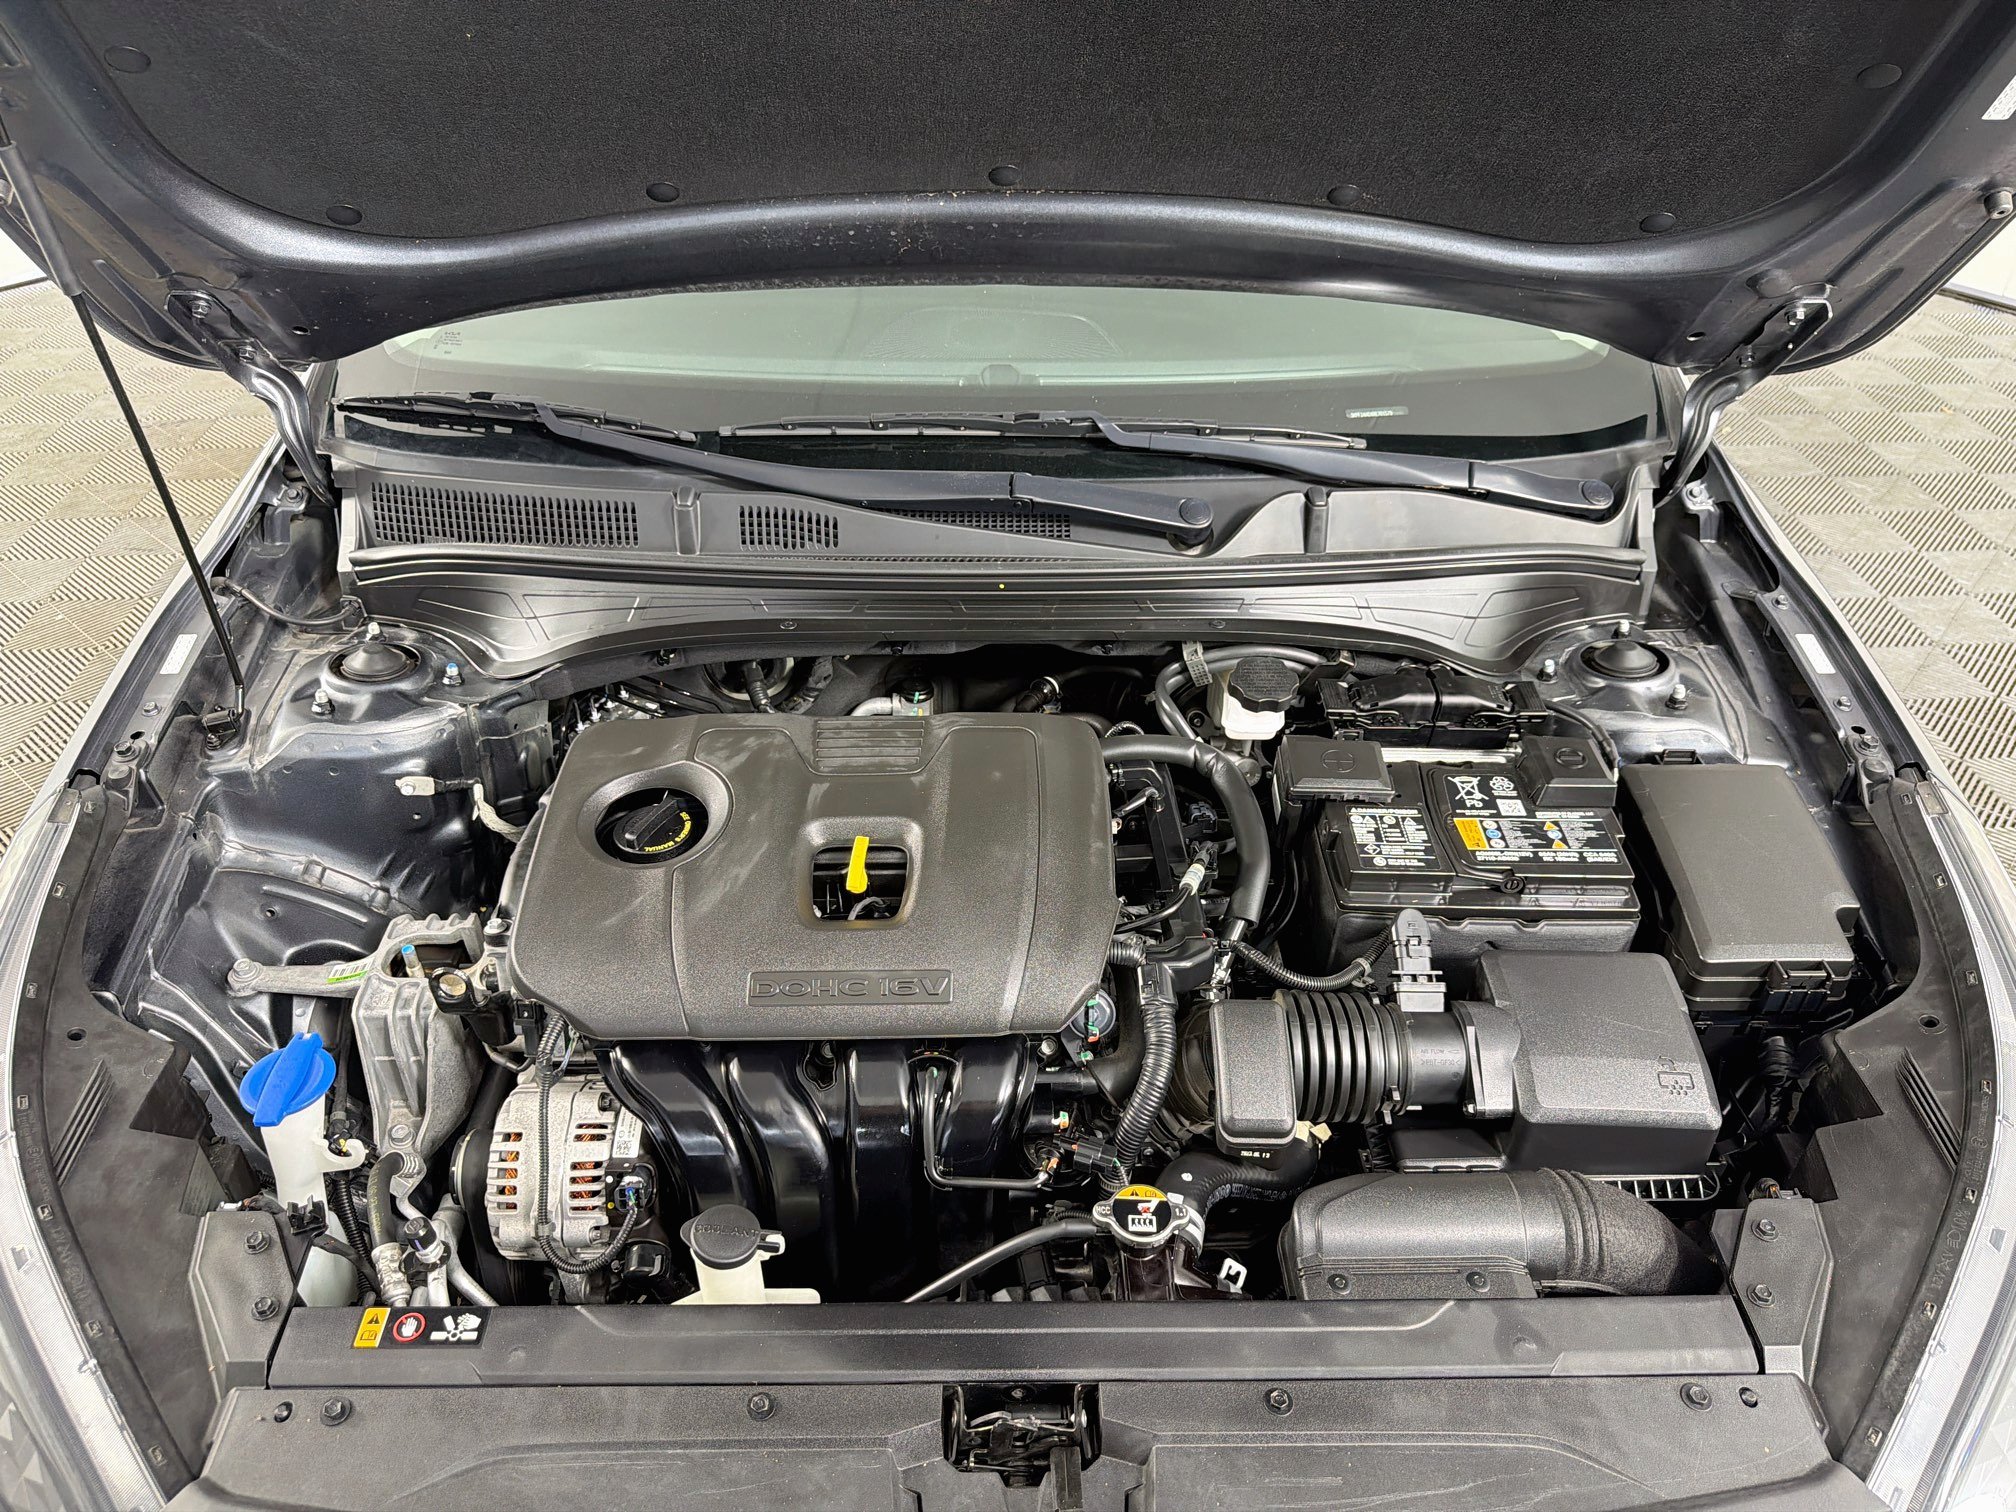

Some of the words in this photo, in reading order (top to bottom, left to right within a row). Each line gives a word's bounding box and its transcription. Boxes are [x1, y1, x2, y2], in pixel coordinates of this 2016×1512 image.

[1465, 799, 1484, 808] Pb
[680, 811, 691, 821] SEE
[644, 841, 675, 852] MANUAL
[750, 978, 869, 997] DOHC
[879, 977, 949, 996] 16V
[1096, 1205, 1111, 1214] HCC
[1174, 1208, 1186, 1217] 1.1
[694, 1224, 759, 1238] COOLANT
